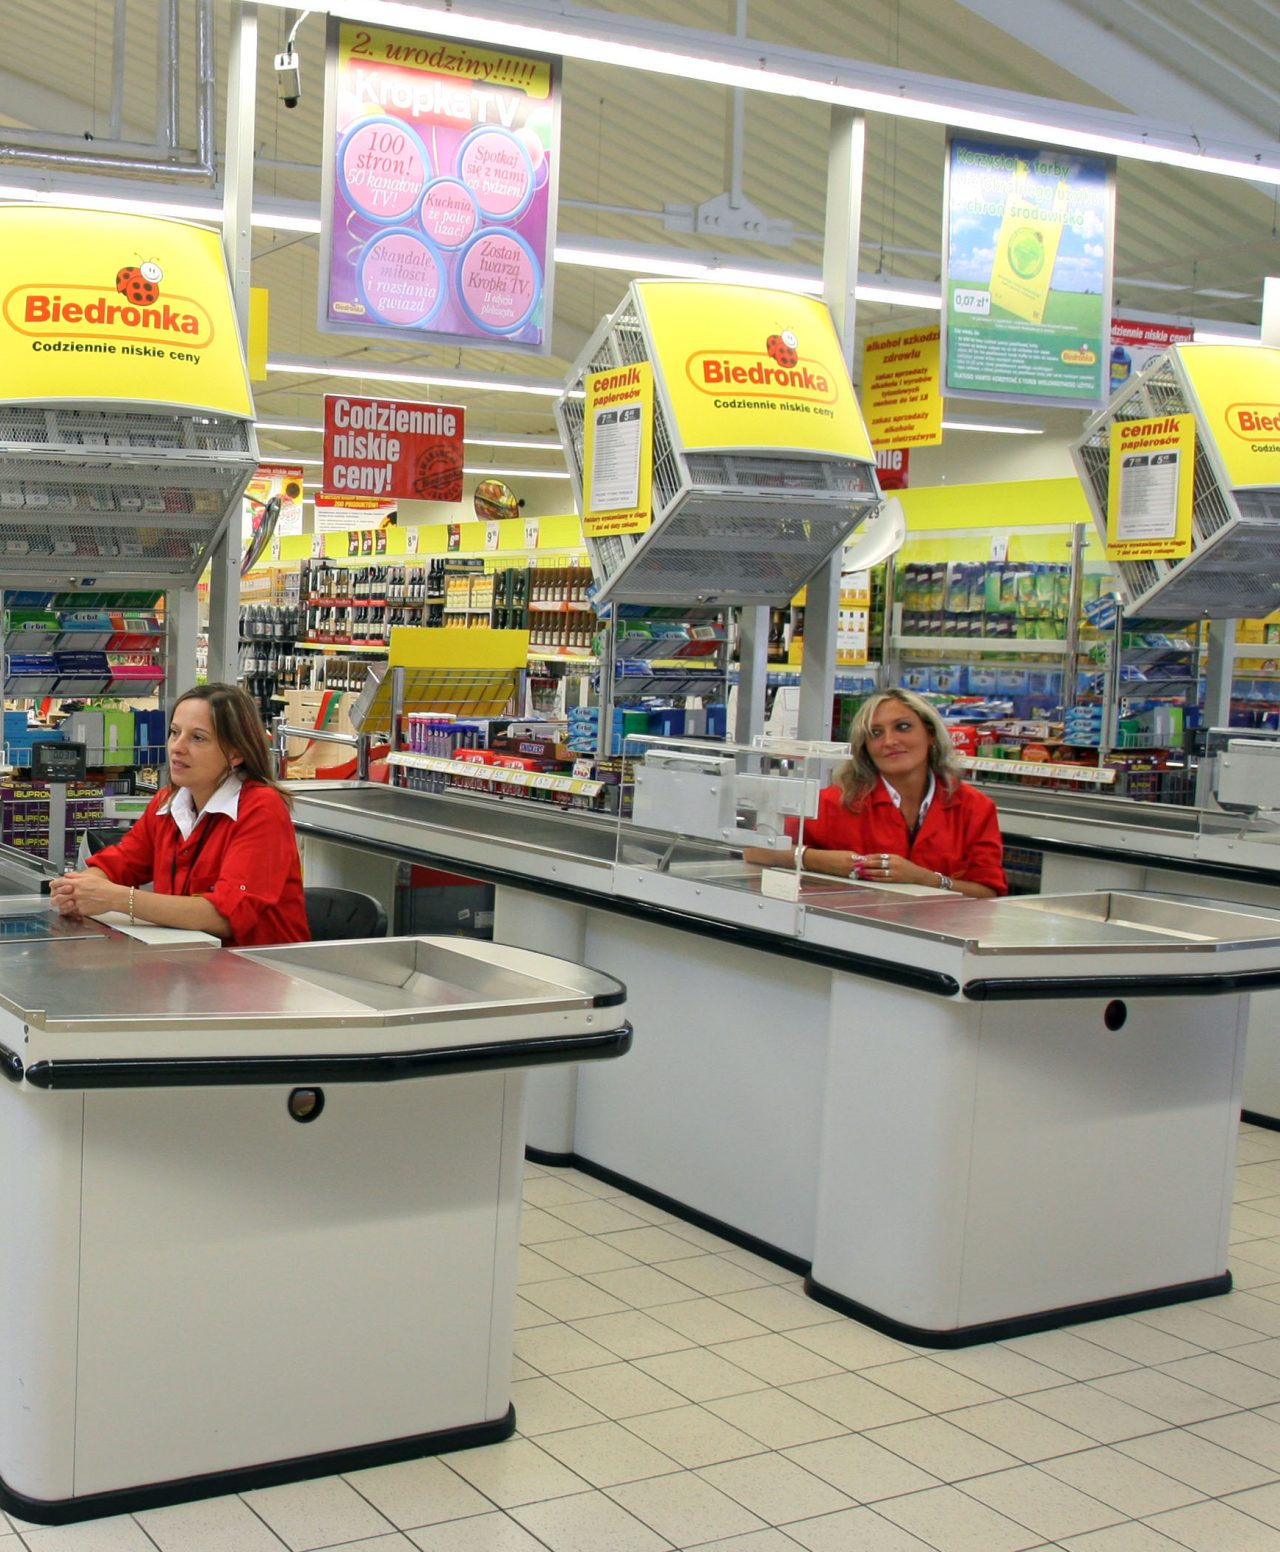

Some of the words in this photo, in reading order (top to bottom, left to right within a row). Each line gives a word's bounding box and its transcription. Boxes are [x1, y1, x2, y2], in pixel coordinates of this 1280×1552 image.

[350, 31, 374, 56] 2.
[369, 131, 405, 155] 100
[356, 151, 414, 176] stron!
[475, 145, 519, 167] Spotkaj
[467, 162, 481, 177] się
[485, 166, 491, 176] z
[494, 166, 527, 183] nami
[1035, 160, 1070, 179] torby
[480, 240, 521, 262] Zostań
[479, 257, 520, 277] twarzą
[376, 279, 437, 298] rozstania
[468, 272, 507, 294] Kropki
[378, 293, 426, 313] gwiazd
[24, 294, 199, 336] Biedronka
[32, 340, 117, 354] Codziennie
[121, 345, 166, 359] niskie
[169, 351, 201, 365] ceny
[593, 367, 641, 393] cennik
[703, 360, 829, 393] Biedronka
[593, 387, 641, 409] papierosów
[713, 399, 776, 410] Codziennie
[780, 402, 811, 414] niskie
[813, 406, 834, 419] ceny
[334, 399, 456, 437] Codziennie
[1121, 418, 1180, 438] cennik
[333, 431, 400, 462] niskie
[1120, 435, 1181, 451] papierosów
[333, 464, 393, 494] ceny!
